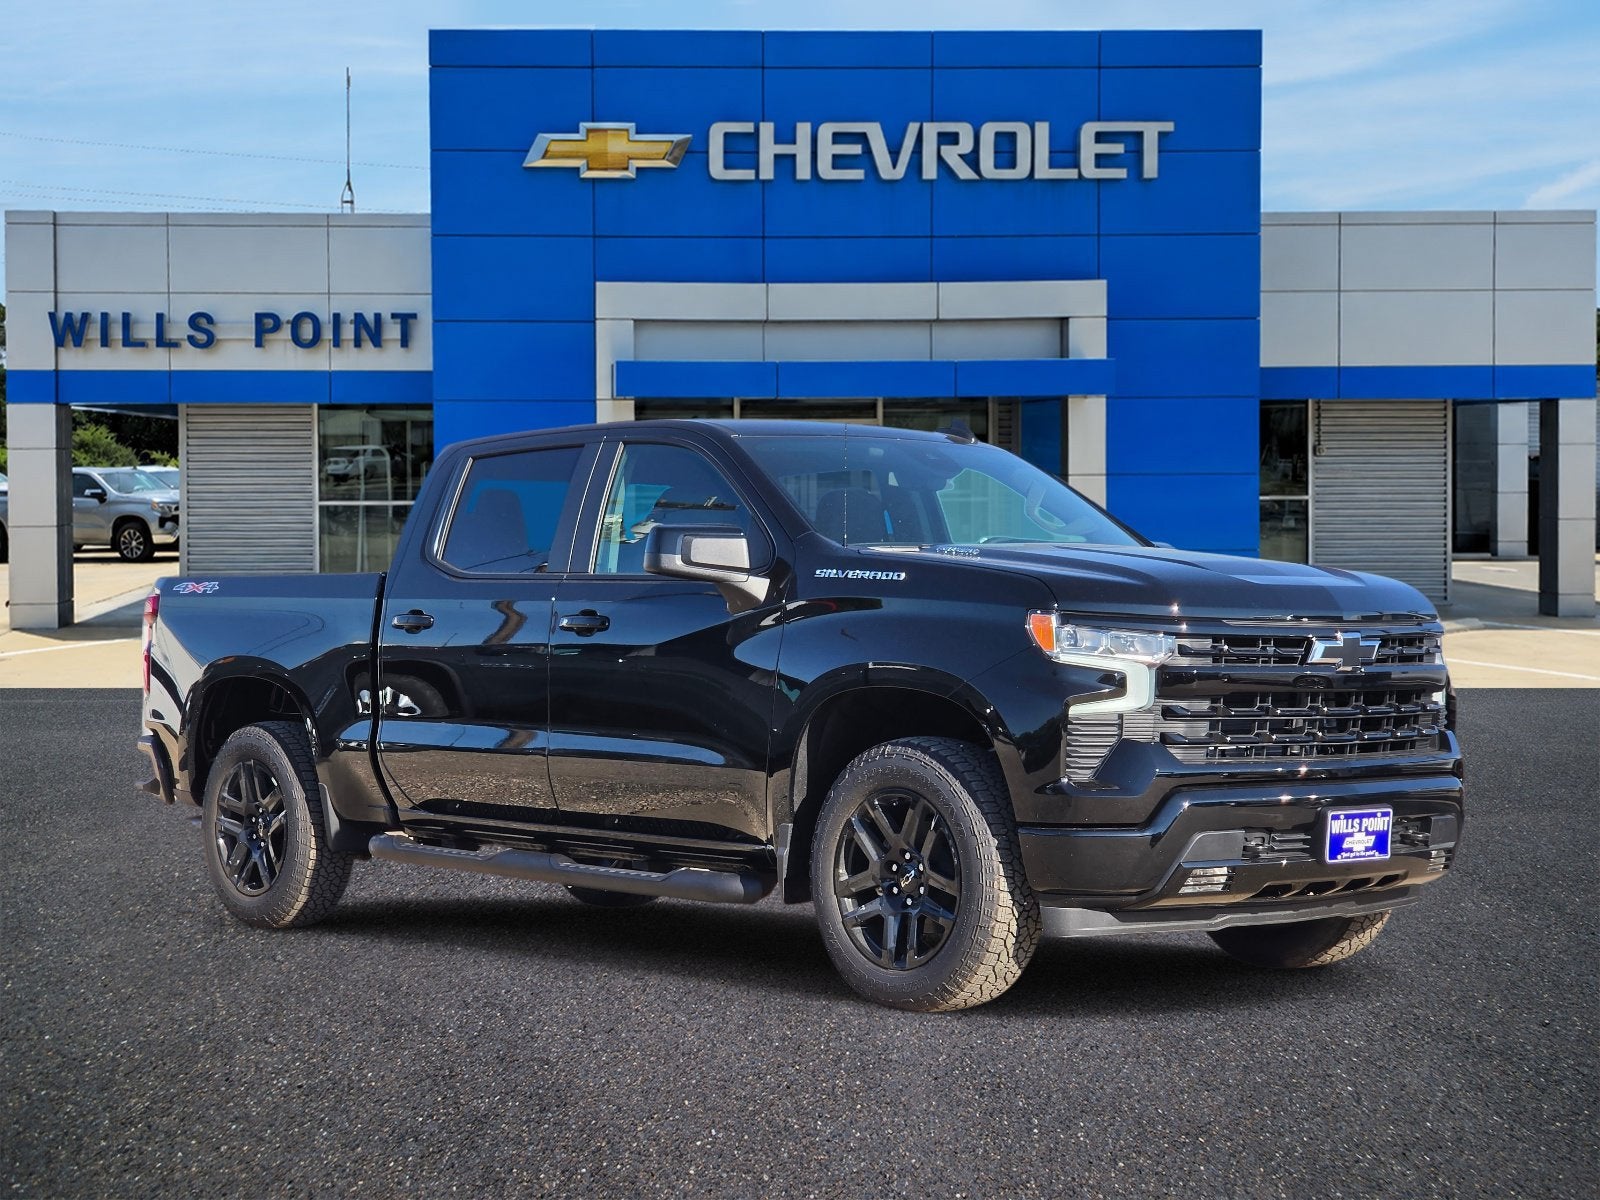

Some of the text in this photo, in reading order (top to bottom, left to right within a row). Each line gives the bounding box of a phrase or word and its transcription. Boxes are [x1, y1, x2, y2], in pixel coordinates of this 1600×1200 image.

[708, 121, 1175, 181] CHEVROLET
[48, 311, 418, 349] WILLS POINT
[814, 568, 906, 581] SILVERADO
[1331, 817, 1389, 834] WILLS POINT
